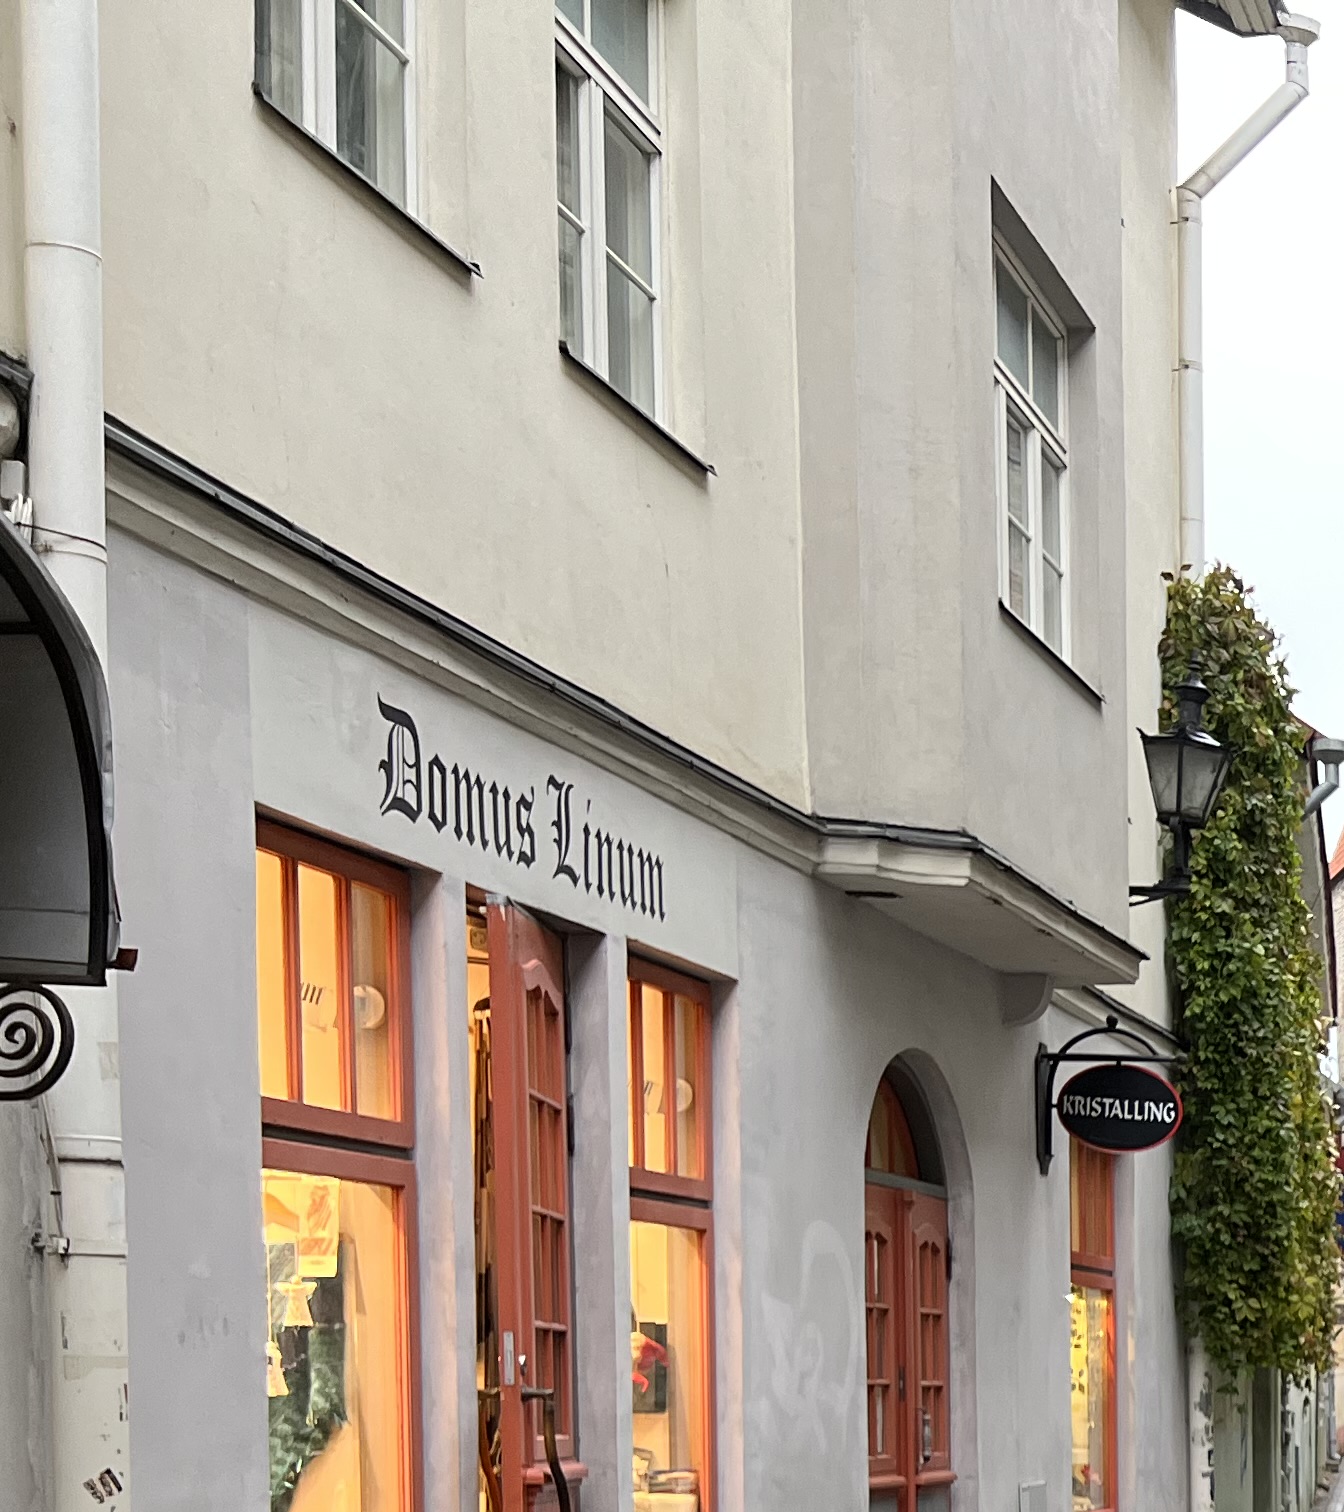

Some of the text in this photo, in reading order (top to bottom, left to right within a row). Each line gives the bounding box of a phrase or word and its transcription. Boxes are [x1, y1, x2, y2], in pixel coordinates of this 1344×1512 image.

[376, 691, 667, 924] Domus Linum
[1062, 1094, 1176, 1124] KRISTALLING
